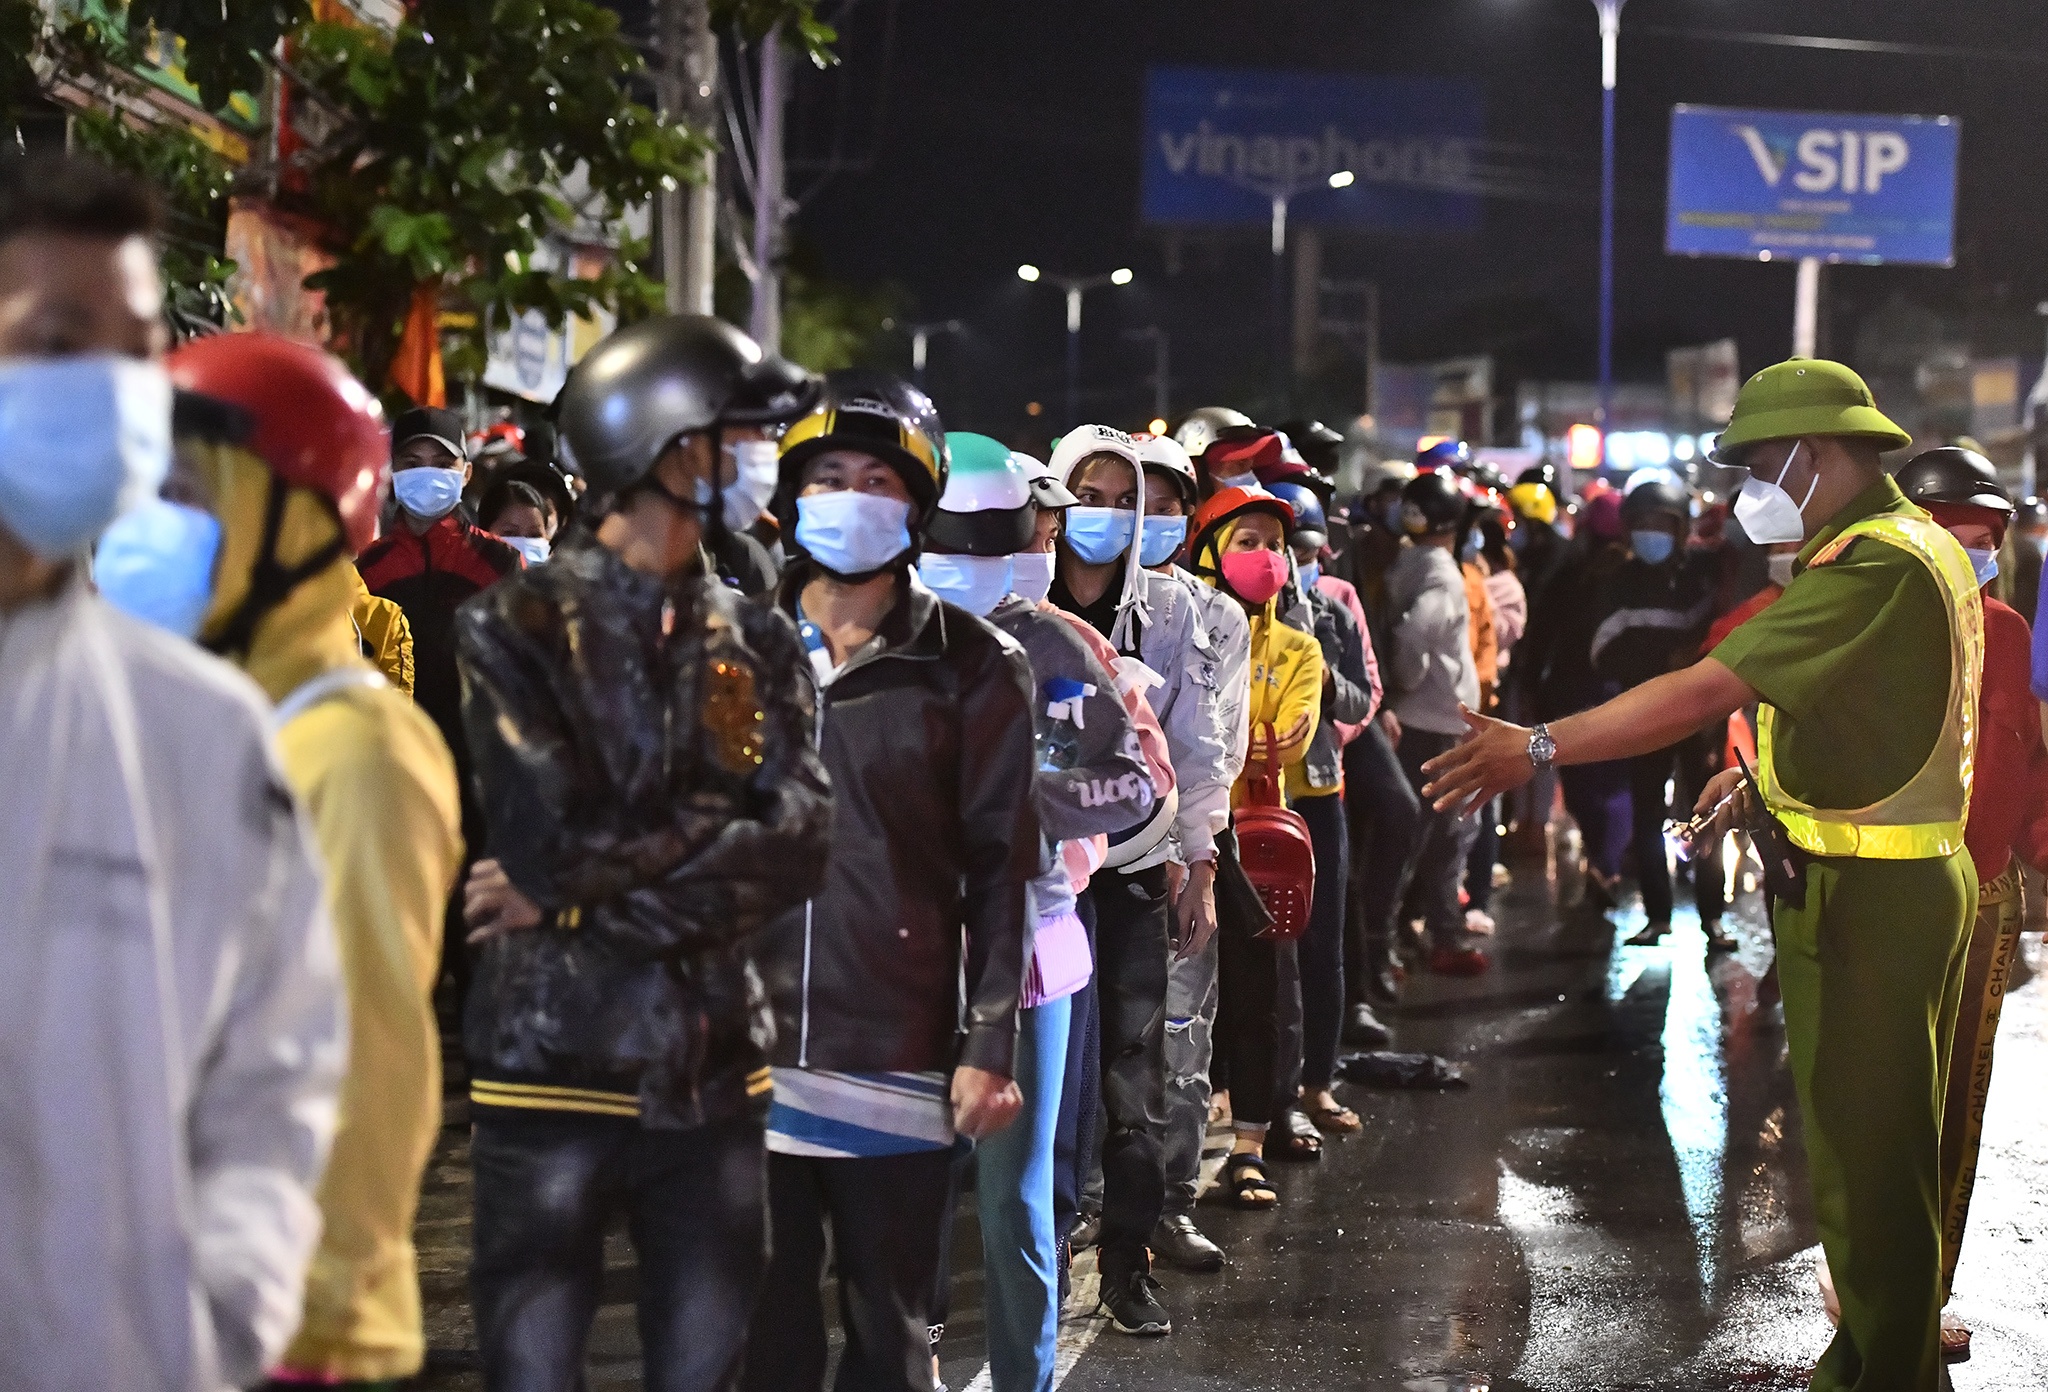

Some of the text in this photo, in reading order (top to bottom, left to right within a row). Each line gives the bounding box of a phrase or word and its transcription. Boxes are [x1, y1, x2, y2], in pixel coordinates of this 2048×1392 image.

[1159, 119, 1471, 184] vinaphone
[1736, 125, 1909, 194] VSIP
[1972, 1036, 1994, 1124] CHANEL
[1990, 911, 2018, 997] CHANEL
